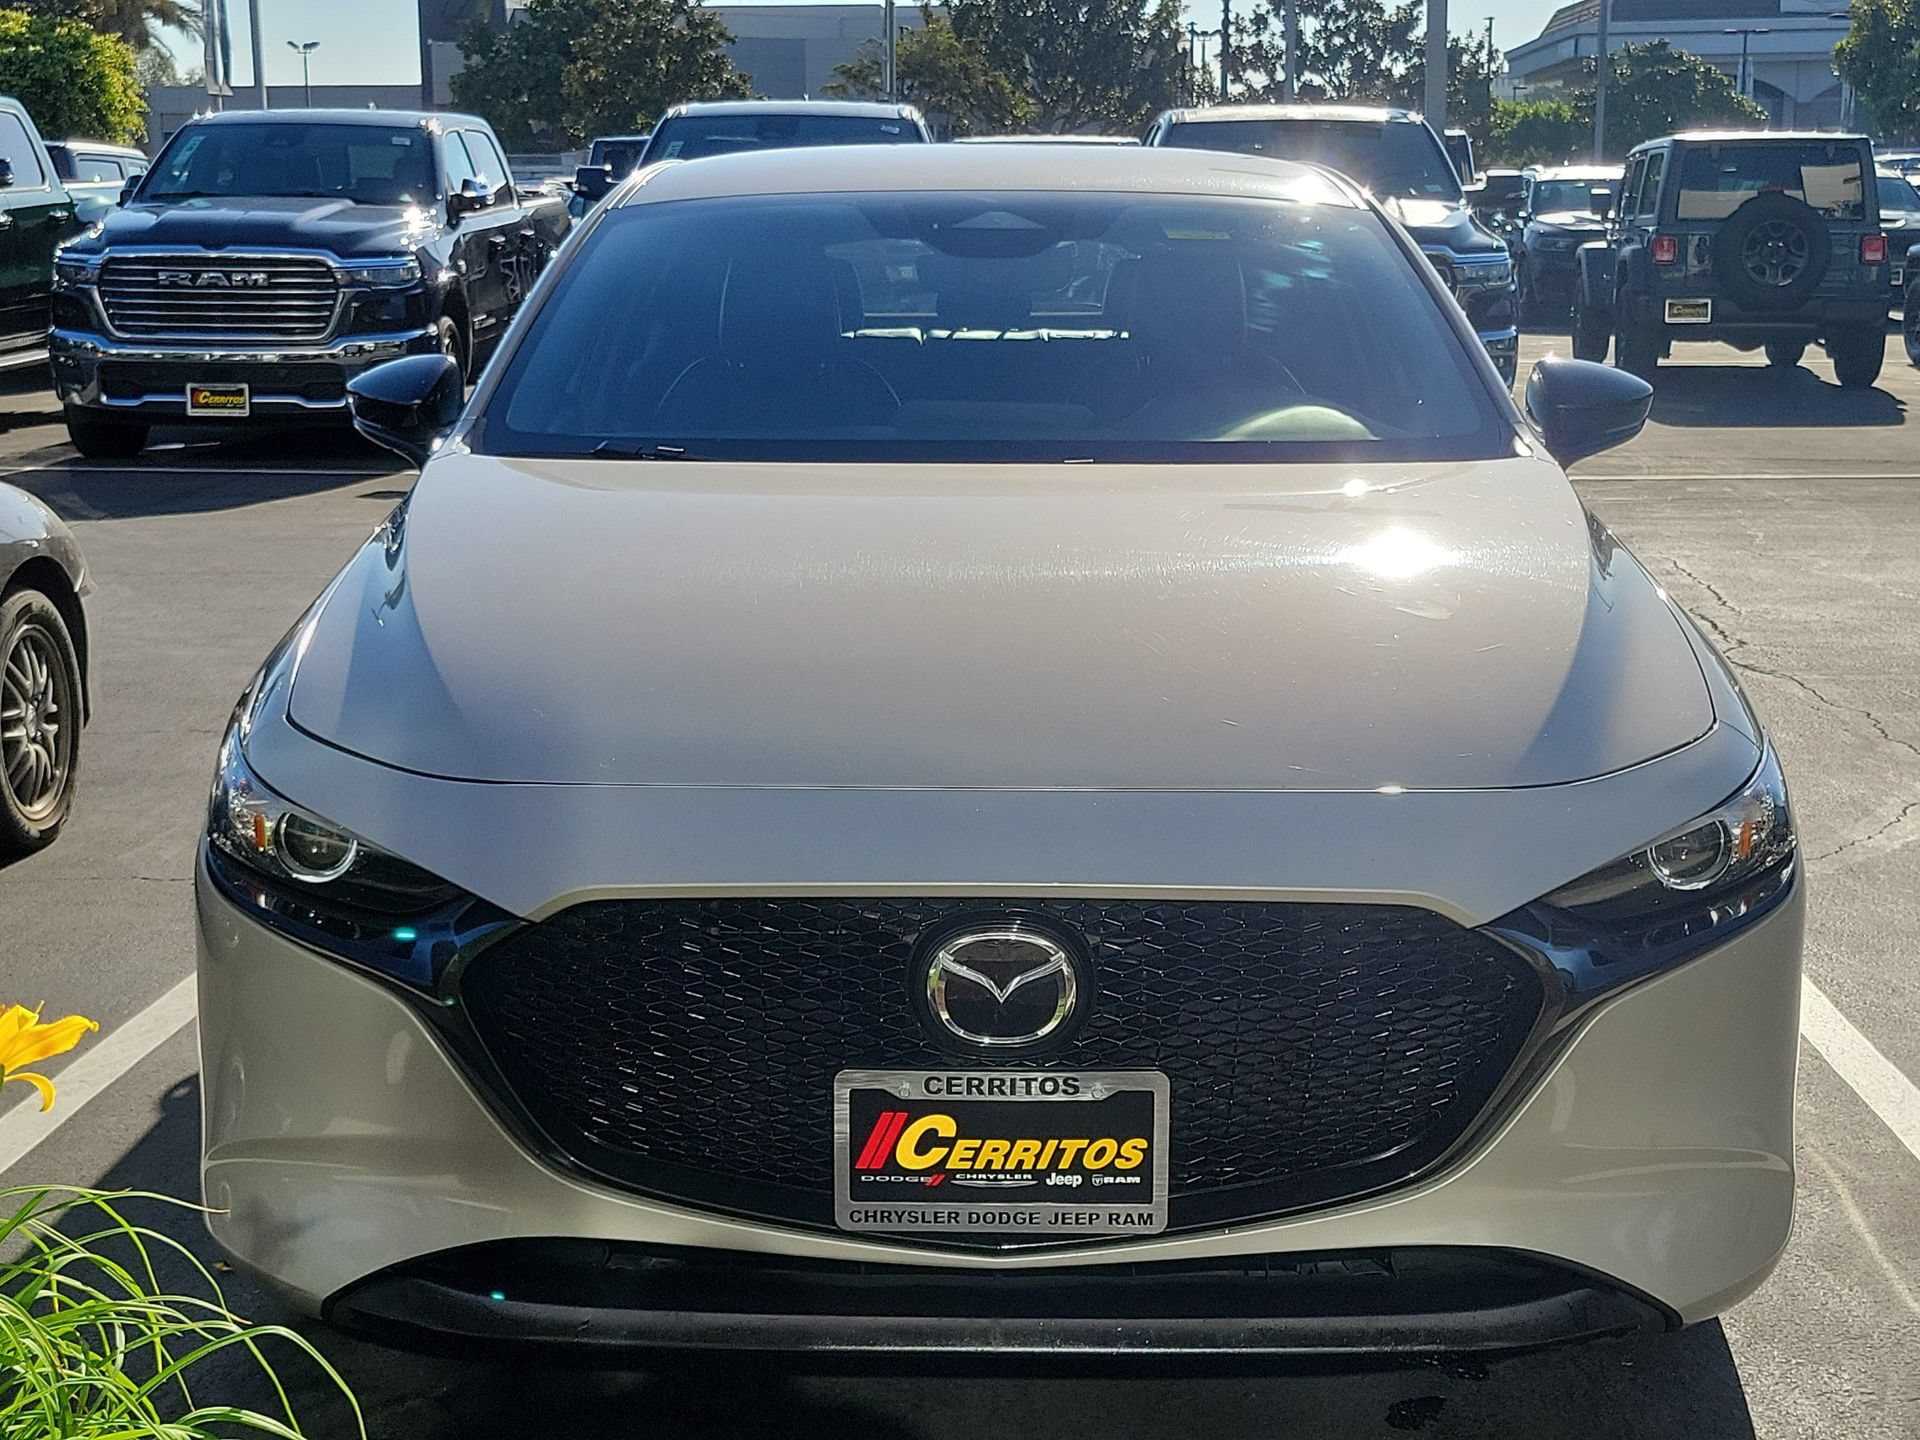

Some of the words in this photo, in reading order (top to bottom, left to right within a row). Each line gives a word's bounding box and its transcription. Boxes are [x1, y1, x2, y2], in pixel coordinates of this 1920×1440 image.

[158, 271, 268, 287] RAM
[923, 1076, 1080, 1097] CERRITOS
[895, 1114, 1148, 1170] CERRITOS
[861, 1174, 932, 1183] DODGE
[955, 1172, 1032, 1180] CHRYSLER
[1045, 1172, 1083, 1188] Jeep
[1103, 1176, 1141, 1184] RAM
[850, 1209, 960, 1225] CHRYSLER
[967, 1211, 1041, 1226] DODGE
[1047, 1212, 1101, 1227] JEEP
[1107, 1212, 1154, 1227] RAM
